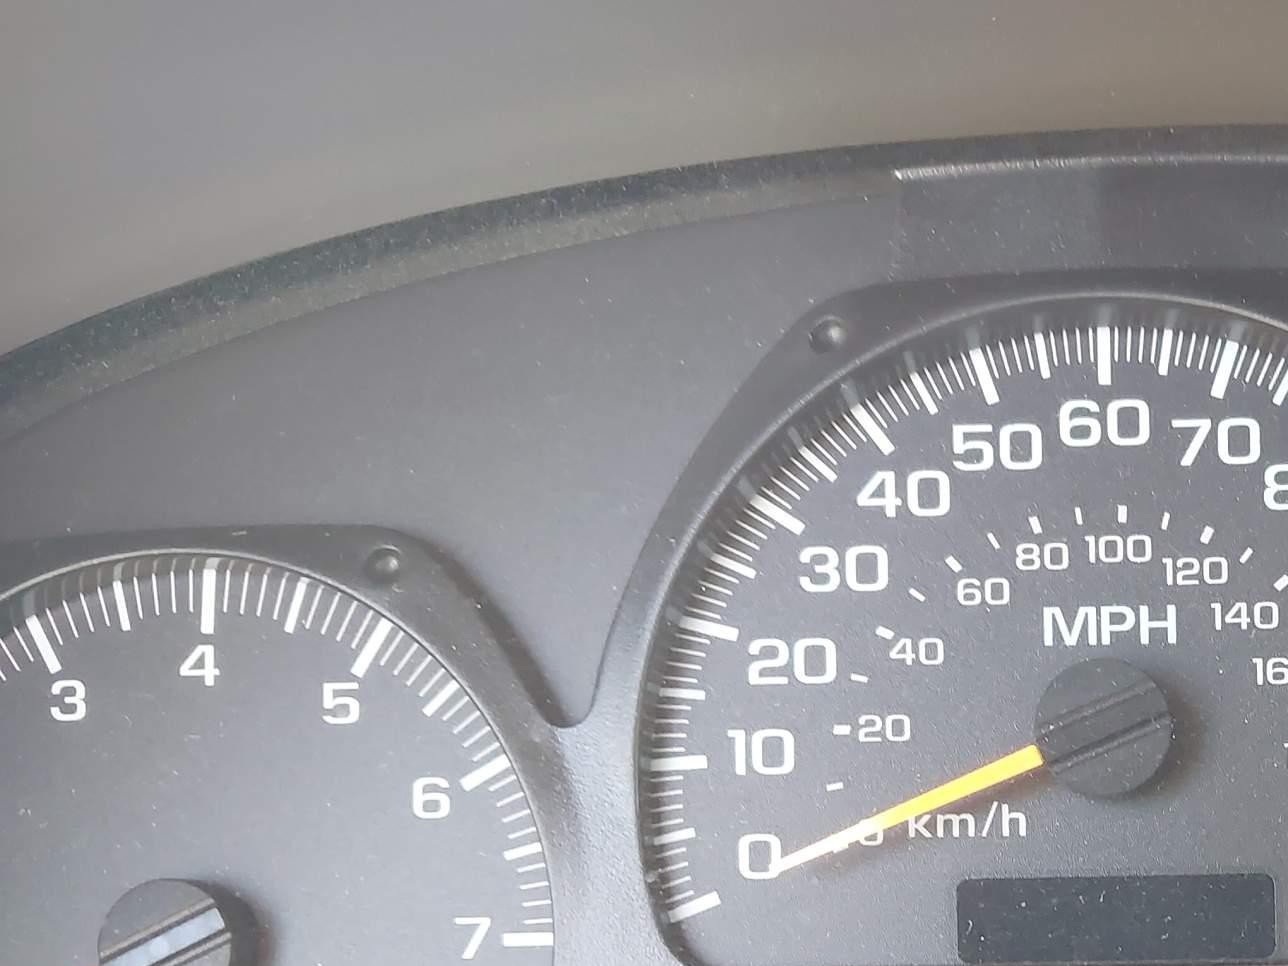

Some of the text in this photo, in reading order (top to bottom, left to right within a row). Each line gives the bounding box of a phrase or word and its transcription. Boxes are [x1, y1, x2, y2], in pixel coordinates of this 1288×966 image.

[1059, 399, 1149, 446] 60
[1172, 418, 1260, 466] 70
[953, 424, 1042, 471] 50
[857, 470, 950, 517] 40
[800, 545, 888, 592] 30
[1016, 543, 1069, 570] 80
[1085, 535, 1151, 563] 100
[957, 578, 1009, 605] 60
[1162, 557, 1228, 585] 120
[1043, 605, 1176, 646] MPH
[1211, 602, 1278, 630] 140
[180, 645, 220, 686] 4
[748, 638, 836, 685] 20
[889, 637, 944, 665] 40
[51, 680, 86, 721] 3
[323, 682, 359, 724] 5
[859, 715, 910, 742] 20
[728, 729, 794, 775] 10
[413, 777, 450, 818] 6
[908, 802, 1026, 838] km/h
[738, 834, 781, 879] 0
[454, 917, 490, 959] 7
